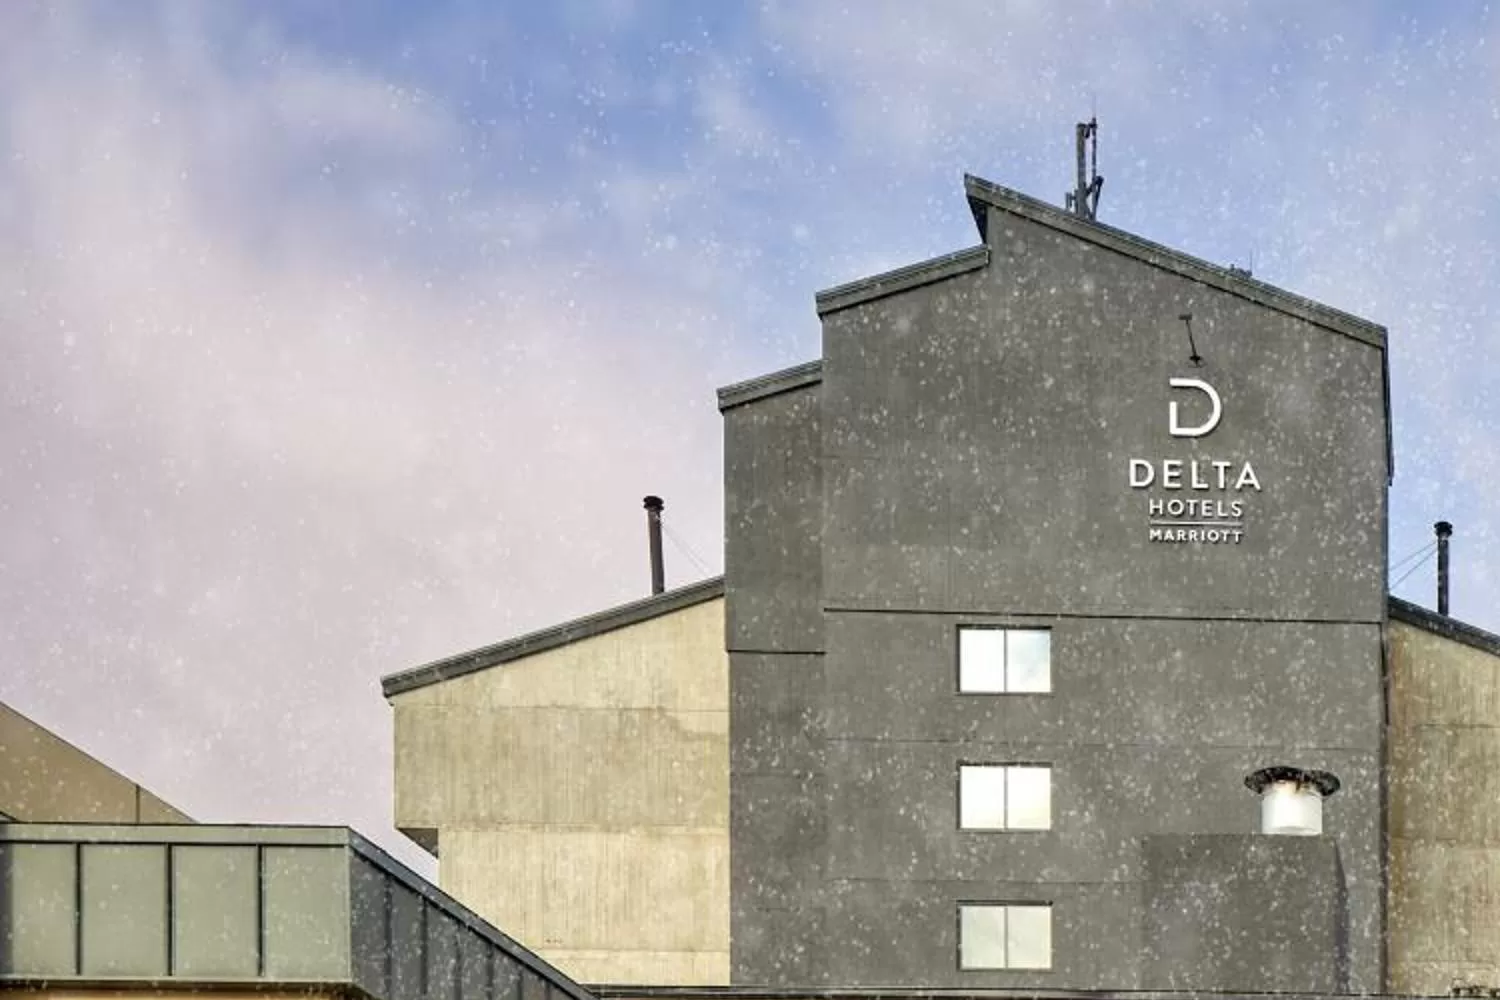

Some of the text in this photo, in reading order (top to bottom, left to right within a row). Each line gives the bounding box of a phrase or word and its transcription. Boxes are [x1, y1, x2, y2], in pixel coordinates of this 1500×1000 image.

[1169, 377, 1222, 437] D
[1129, 459, 1262, 490] DELTA
[1149, 498, 1243, 518] HOTELS
[1149, 529, 1243, 544] MARRIOTT
